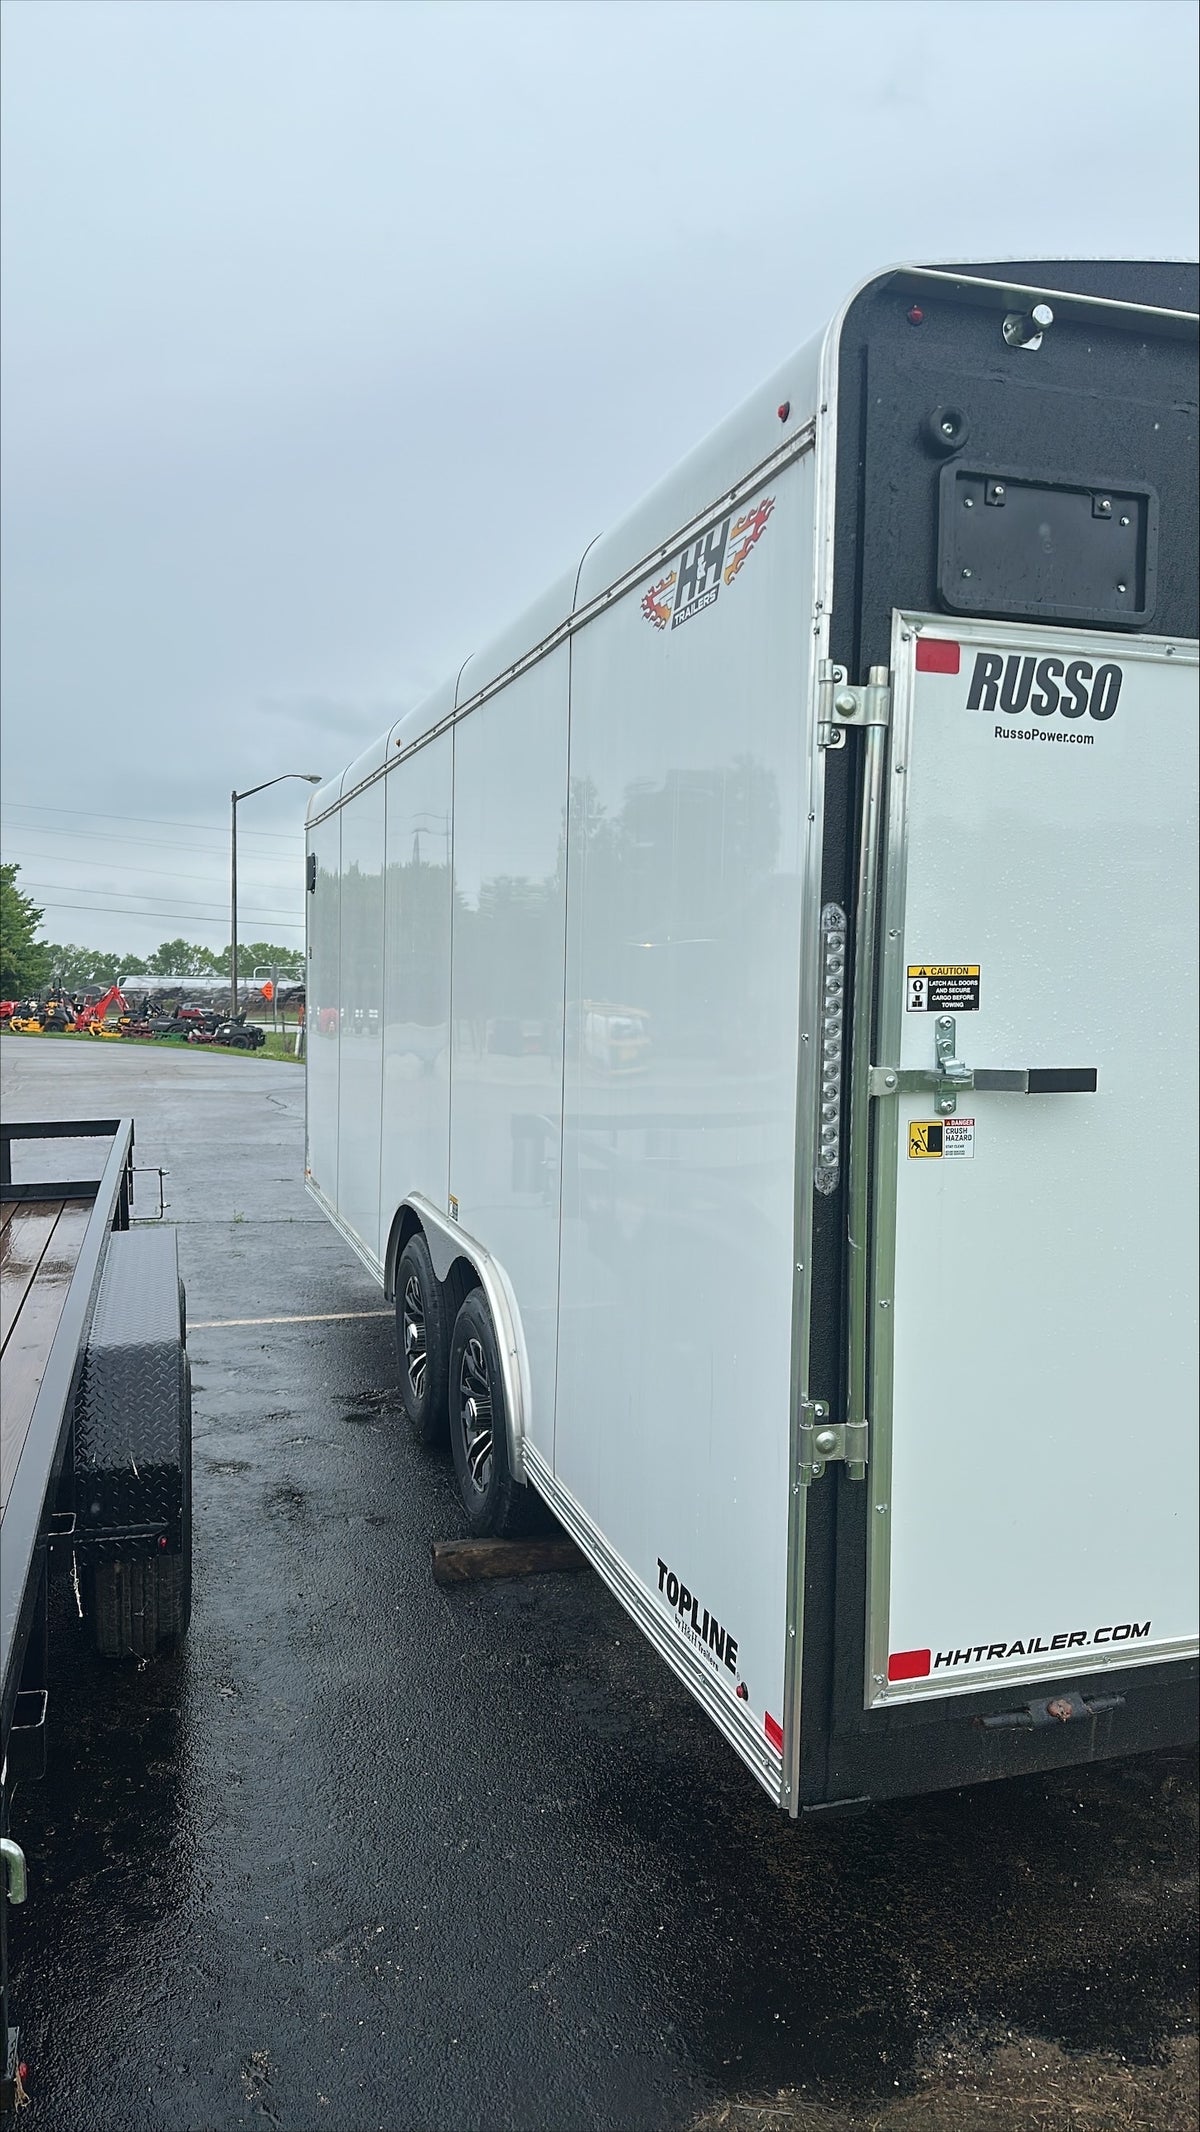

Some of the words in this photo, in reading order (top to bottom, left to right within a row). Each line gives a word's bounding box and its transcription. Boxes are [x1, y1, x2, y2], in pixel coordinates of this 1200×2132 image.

[673, 589, 717, 626] TRAILERS
[966, 652, 1123, 721] RUSSO
[994, 726, 1095, 745] RussoPower.com
[930, 967, 969, 975] CAUTION
[657, 1557, 739, 1675] TOPLINE
[674, 1613, 681, 1628] by
[697, 1640, 719, 1672] Trailers
[933, 1621, 1151, 1668] HHTRAILER.COM
